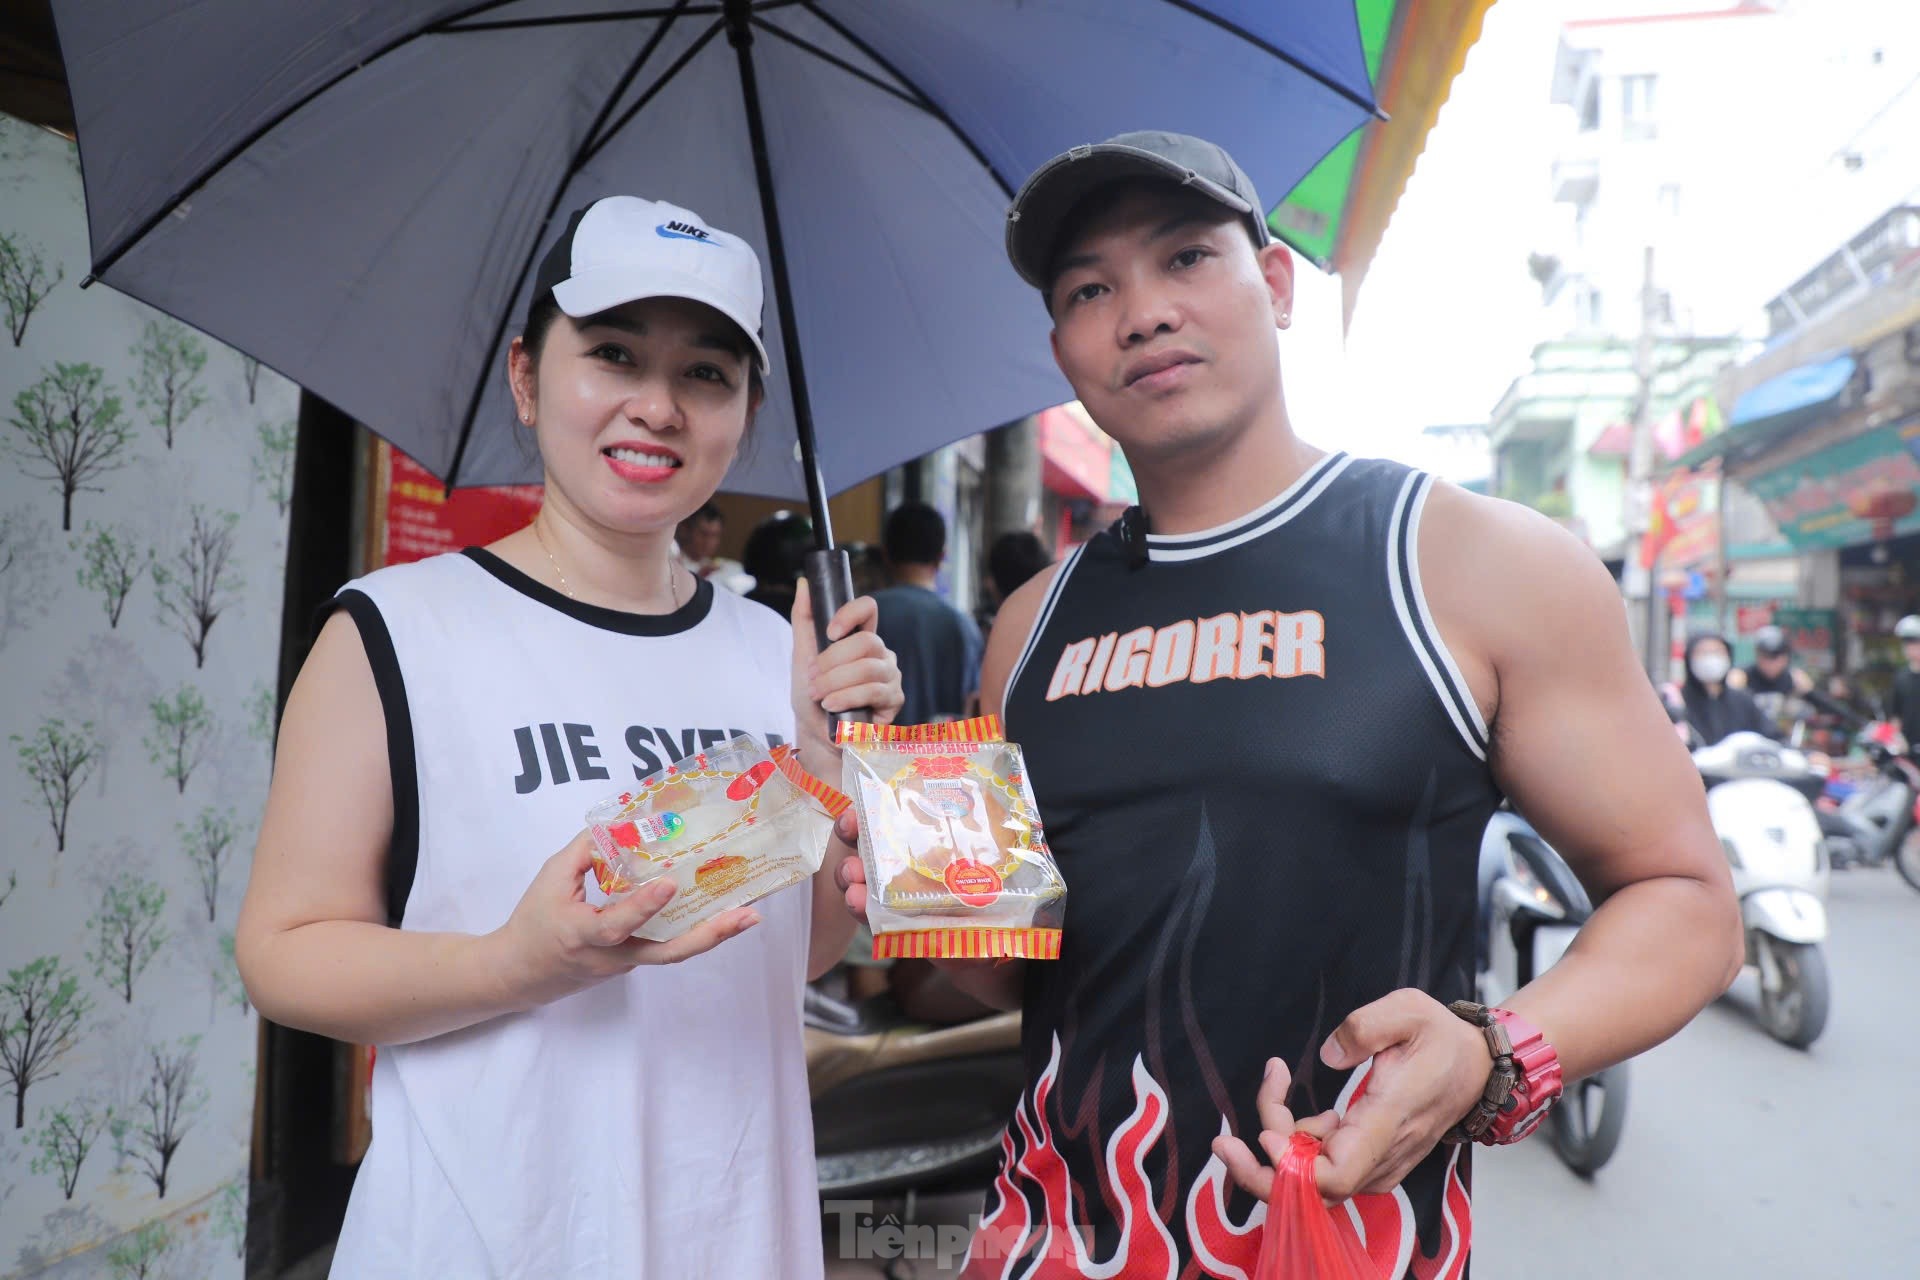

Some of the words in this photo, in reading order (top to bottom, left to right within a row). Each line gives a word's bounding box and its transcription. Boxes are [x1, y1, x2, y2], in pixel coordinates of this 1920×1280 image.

[666, 220, 710, 239] NIKE
[1045, 609, 1327, 702] RIGORER
[513, 722, 611, 795] JIE
